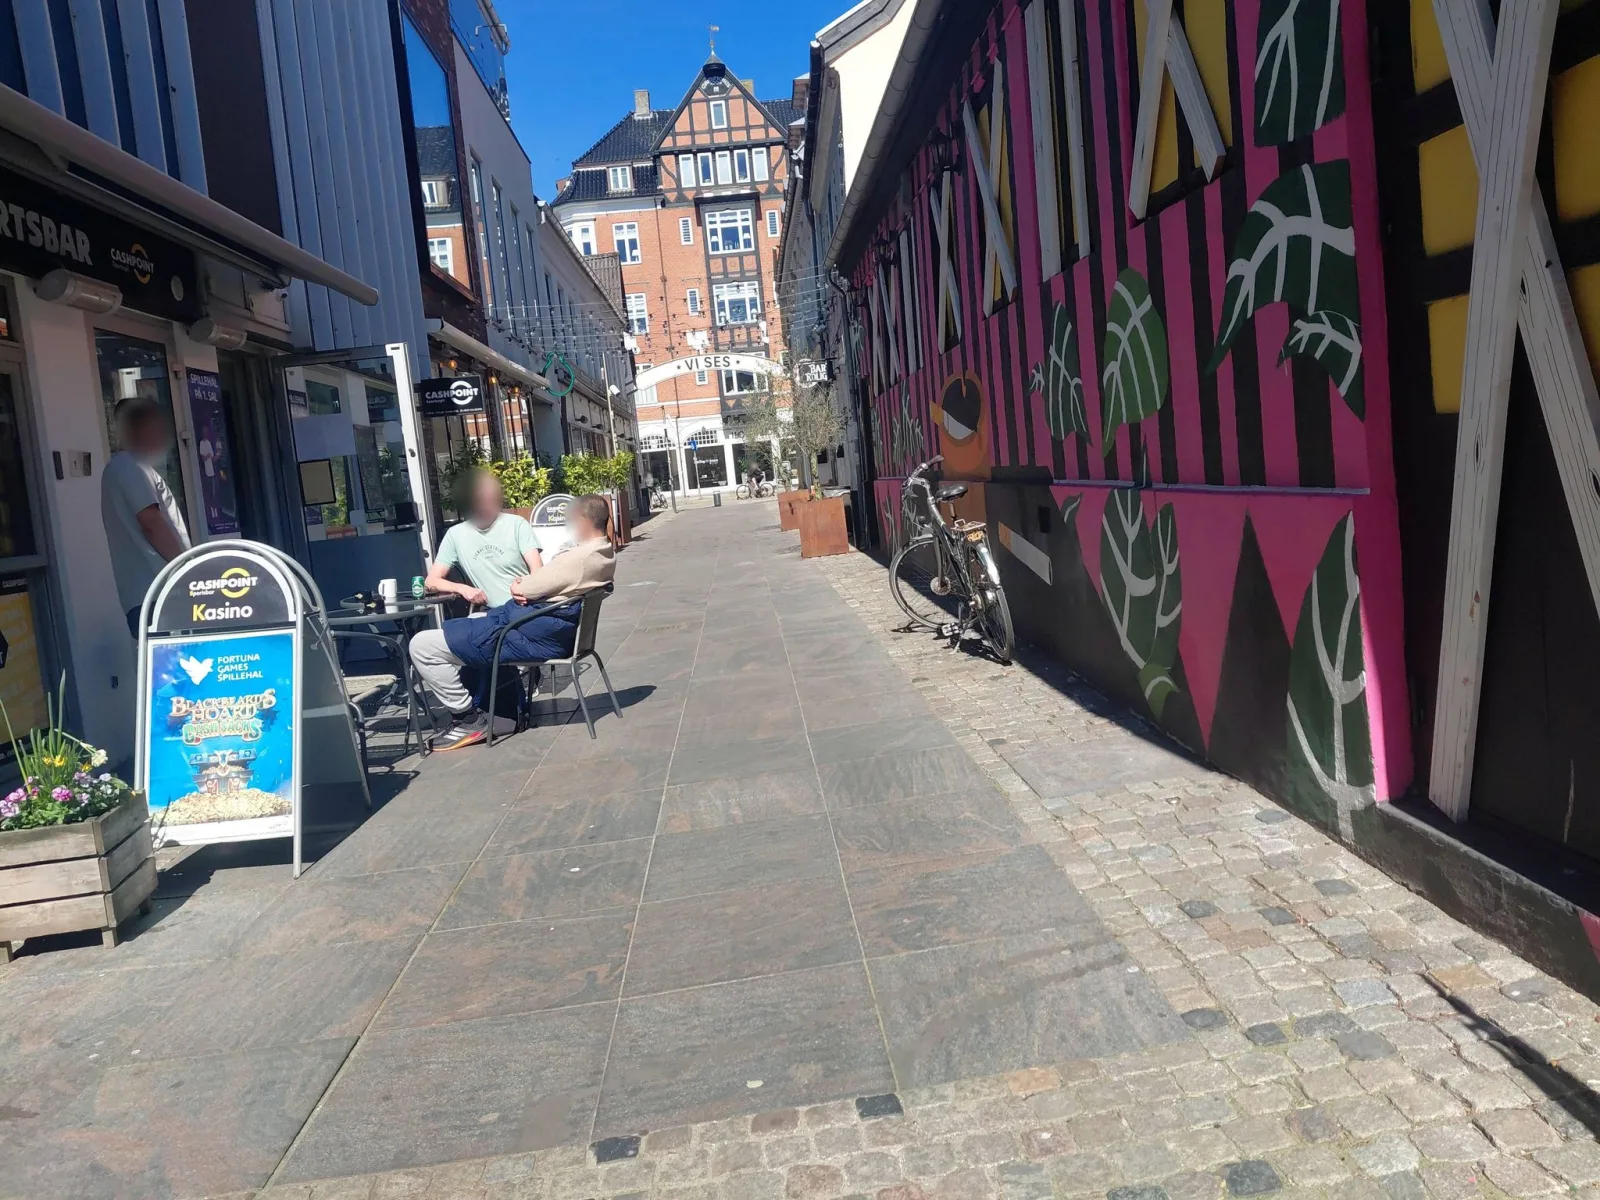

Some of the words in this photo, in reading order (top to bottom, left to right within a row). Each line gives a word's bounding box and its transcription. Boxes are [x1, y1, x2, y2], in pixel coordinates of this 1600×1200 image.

[110, 248, 155, 274] CASHPOINT
[685, 359, 699, 371] VI
[704, 356, 731, 368] SES
[809, 363, 827, 373] BAR
[189, 373, 219, 388] SPILLEHAL
[805, 372, 828, 382] ROLIG
[208, 390, 219, 402] SAL
[425, 388, 479, 399] CASHPOINT
[189, 576, 258, 590] CASHPOINT
[189, 589, 215, 598] Sportsbar
[192, 601, 253, 622] Kasino
[217, 653, 260, 665] FORTUNA
[217, 662, 249, 673] GAMES
[217, 671, 264, 682] SPILLEHAL
[190, 705, 257, 724] HOARD
[182, 722, 219, 746] CASH
[220, 718, 262, 742] SACKS
